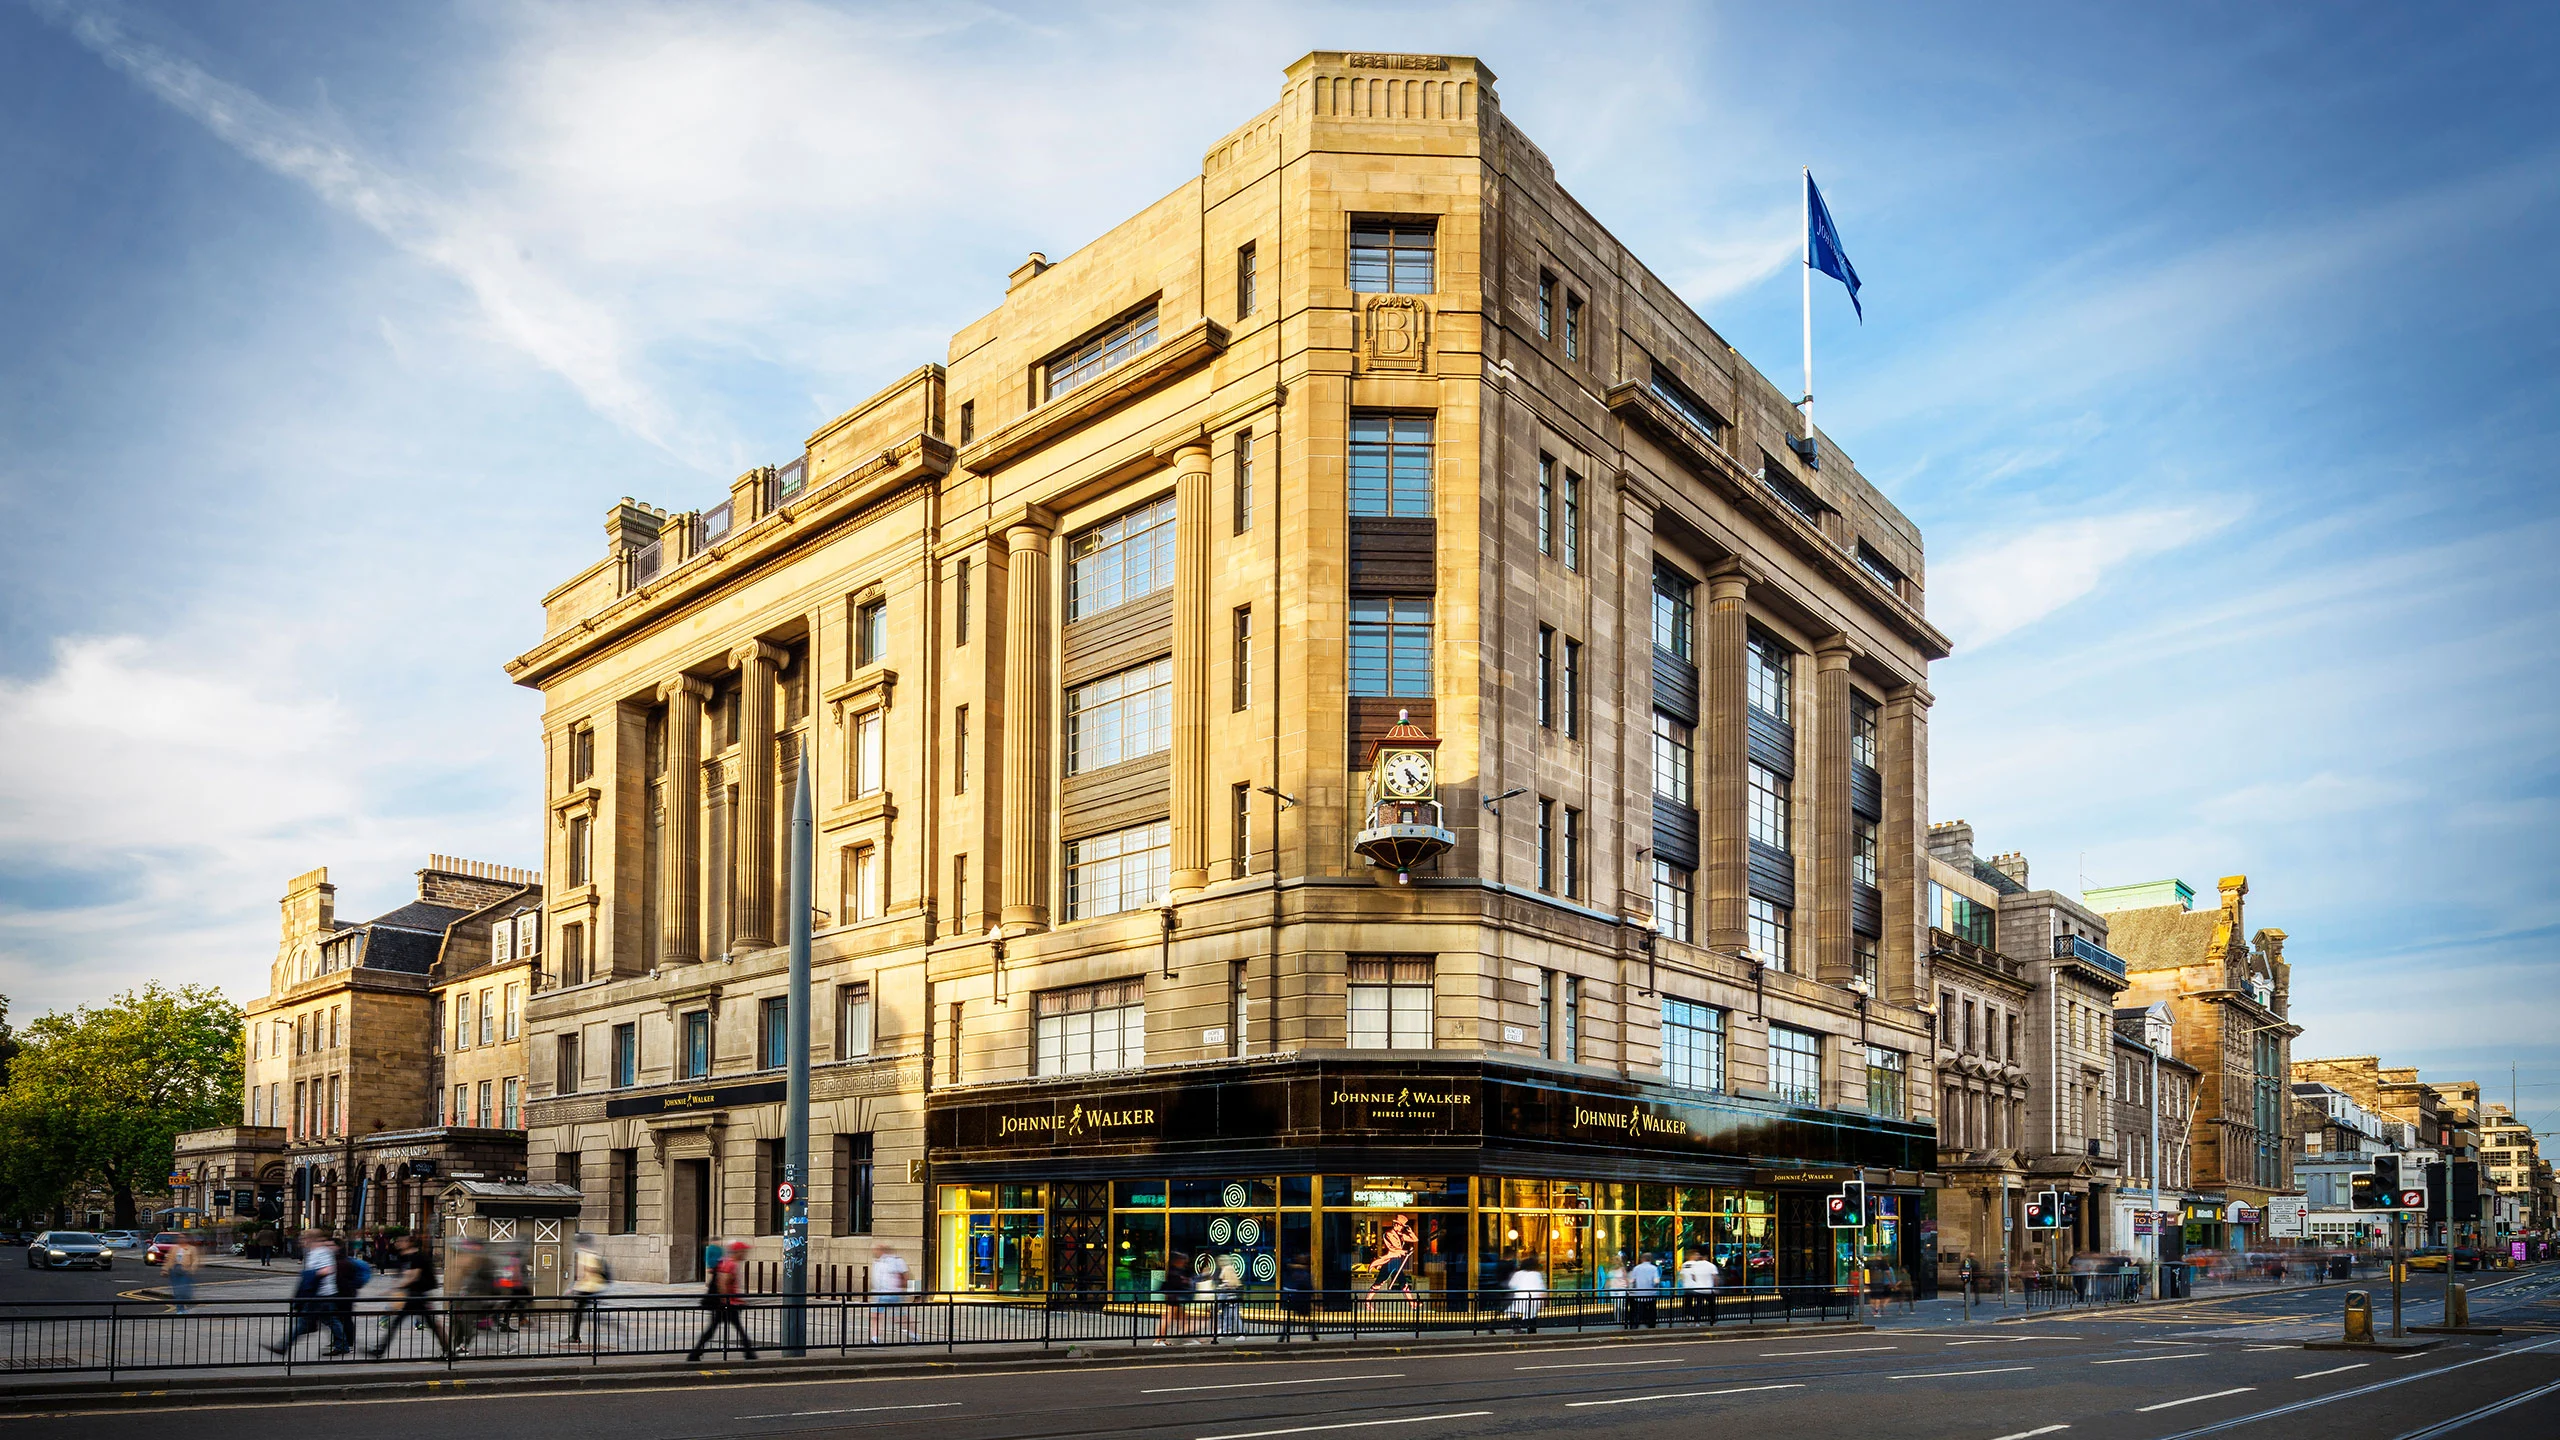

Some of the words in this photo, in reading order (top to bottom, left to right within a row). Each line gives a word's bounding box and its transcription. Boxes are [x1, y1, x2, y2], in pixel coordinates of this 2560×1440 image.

[1382, 311, 1410, 355] B
[664, 1098, 687, 1109] JOHNNIE
[692, 1095, 715, 1104] WALKER
[1331, 1091, 1395, 1105] JOHNNIE
[1413, 1092, 1471, 1104] WALKER
[999, 1115, 1066, 1137] JOHNNIE
[1086, 1109, 1155, 1128] WALKER
[1573, 1106, 1628, 1129] JOHNNIE
[1642, 1113, 1687, 1135] WALKER
[780, 1188, 791, 1197] 20
